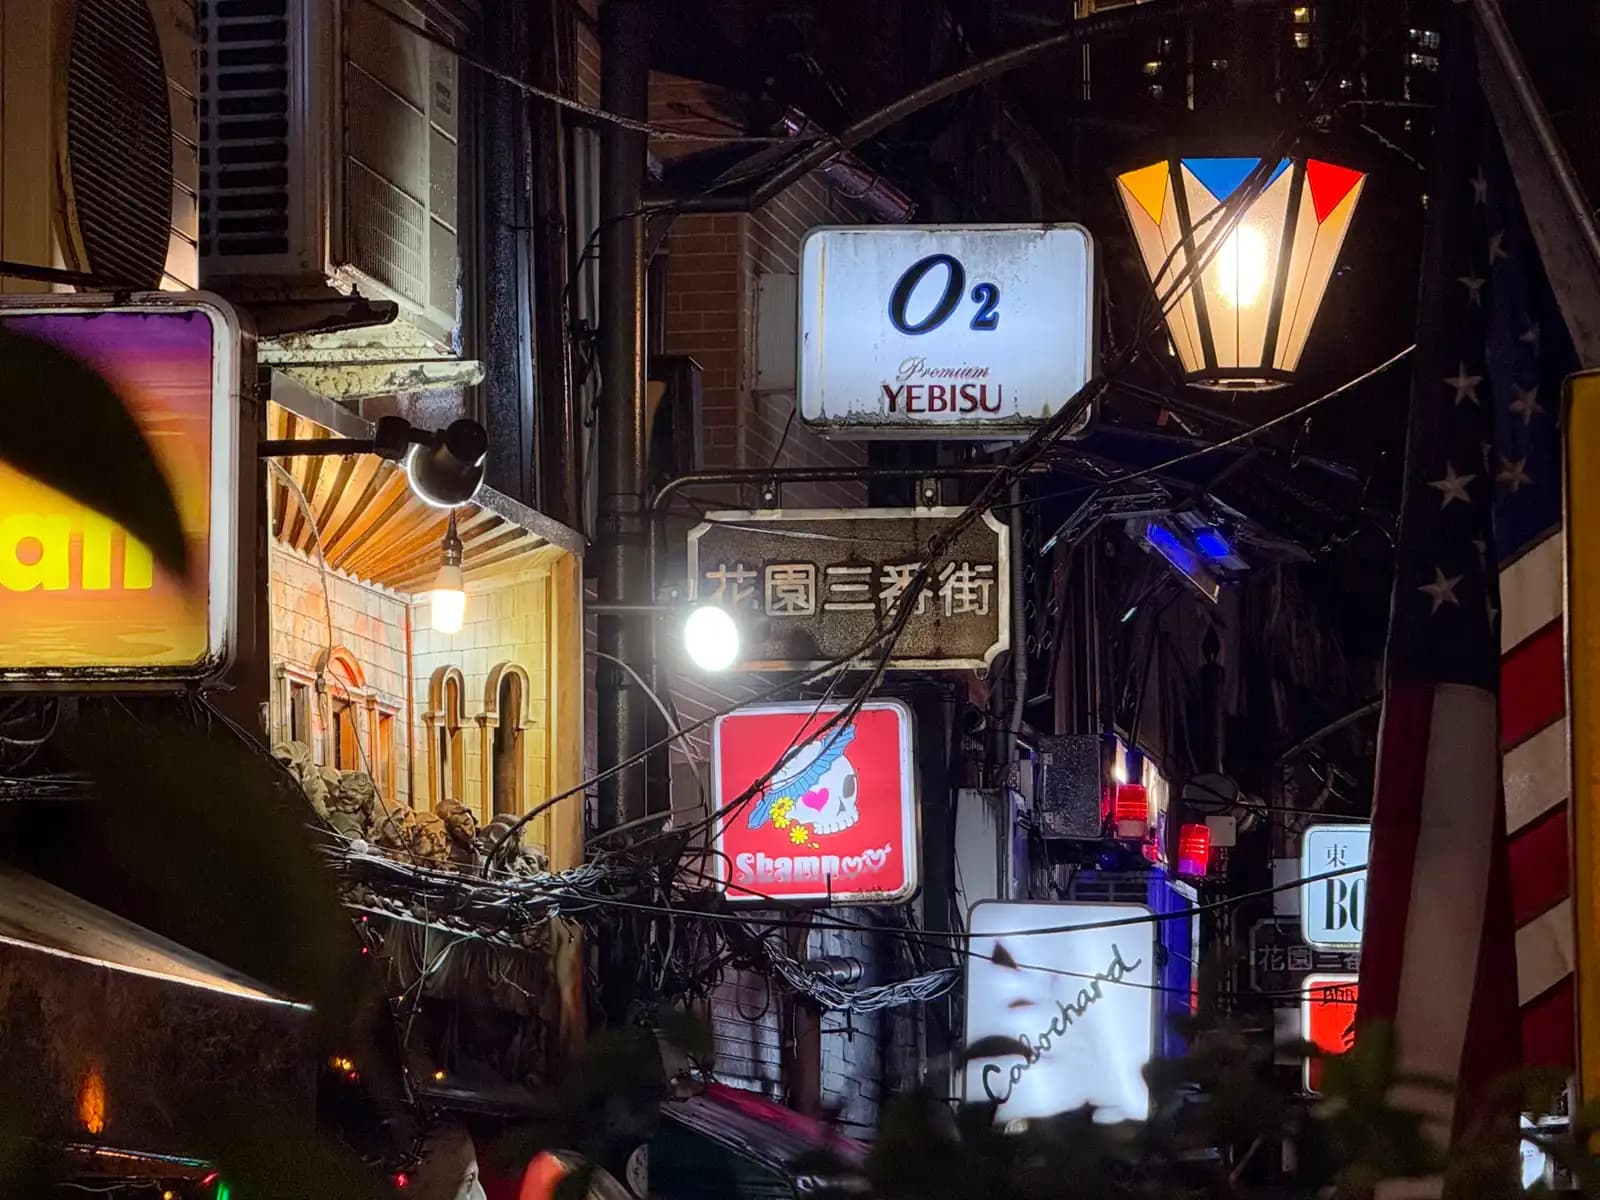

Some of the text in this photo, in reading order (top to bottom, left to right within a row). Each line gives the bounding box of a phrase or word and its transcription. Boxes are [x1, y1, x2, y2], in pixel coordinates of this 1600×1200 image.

[896, 356, 990, 382] Premium
[882, 384, 1003, 413] YEBISU
[704, 562, 995, 617] 花園三番街
